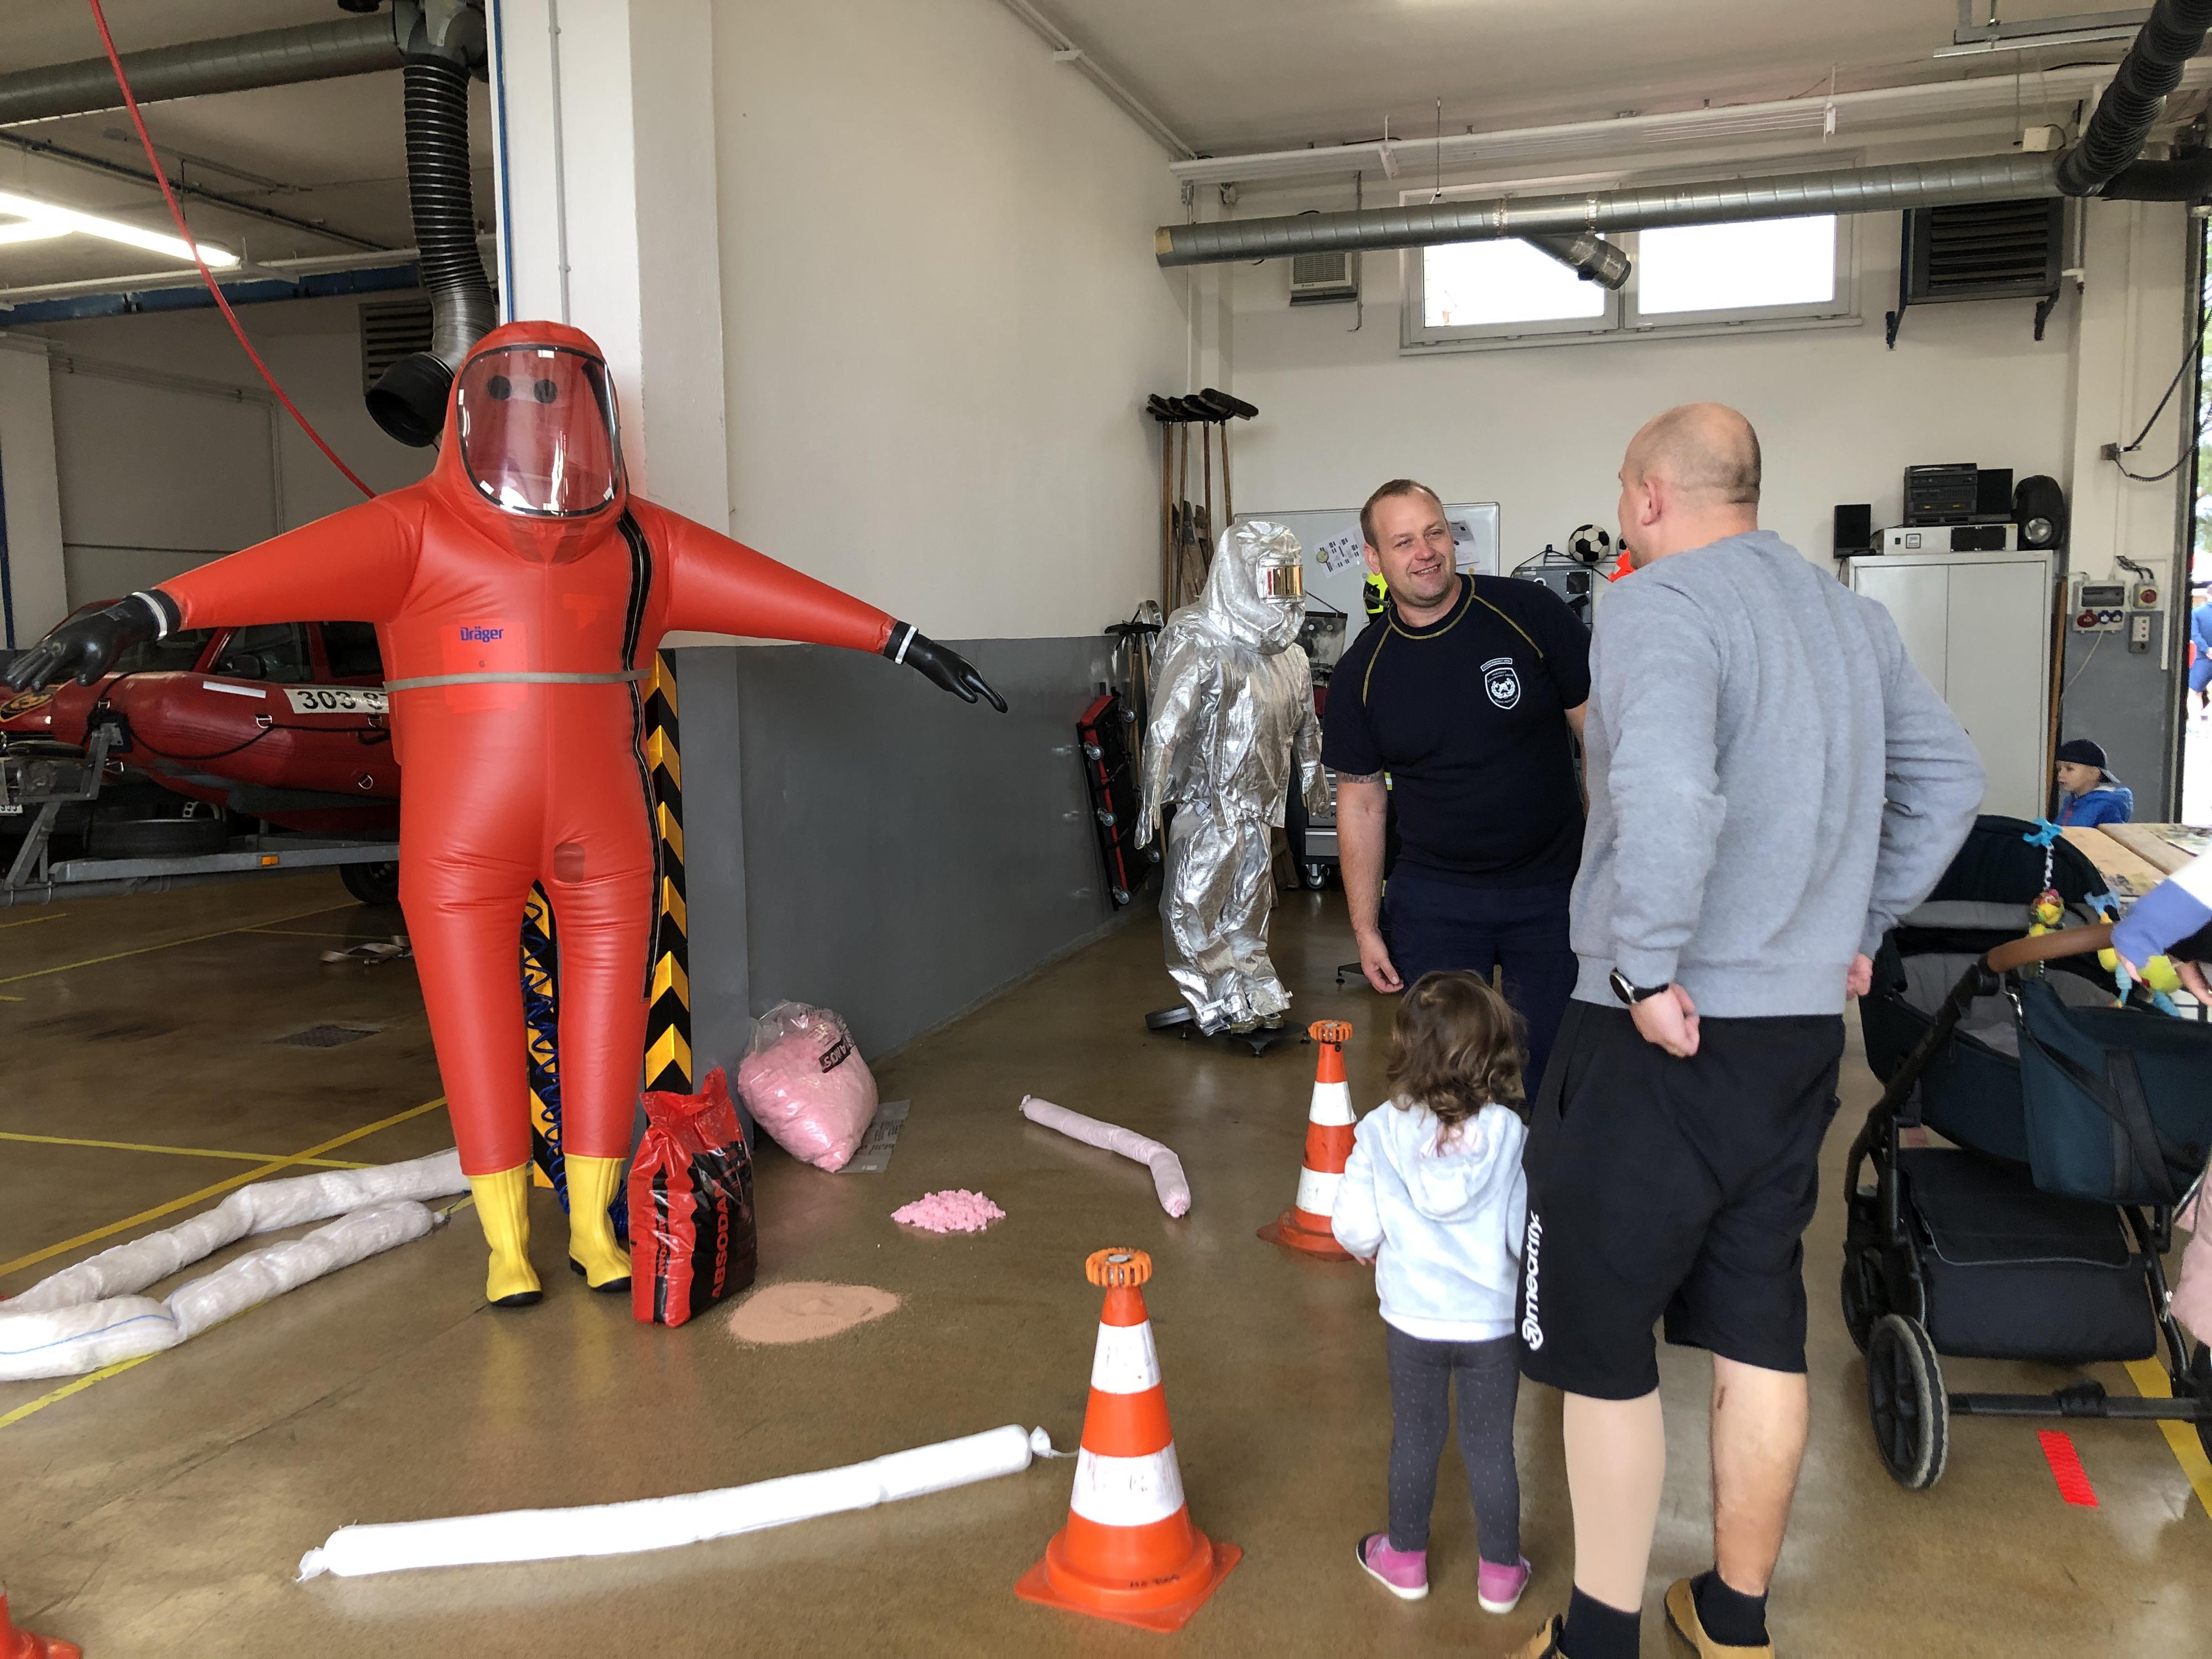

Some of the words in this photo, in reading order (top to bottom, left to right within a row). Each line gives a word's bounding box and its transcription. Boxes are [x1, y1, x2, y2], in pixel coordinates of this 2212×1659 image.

[460, 626, 504, 643] Dräger
[297, 691, 356, 709] 303
[363, 692, 387, 710] 8
